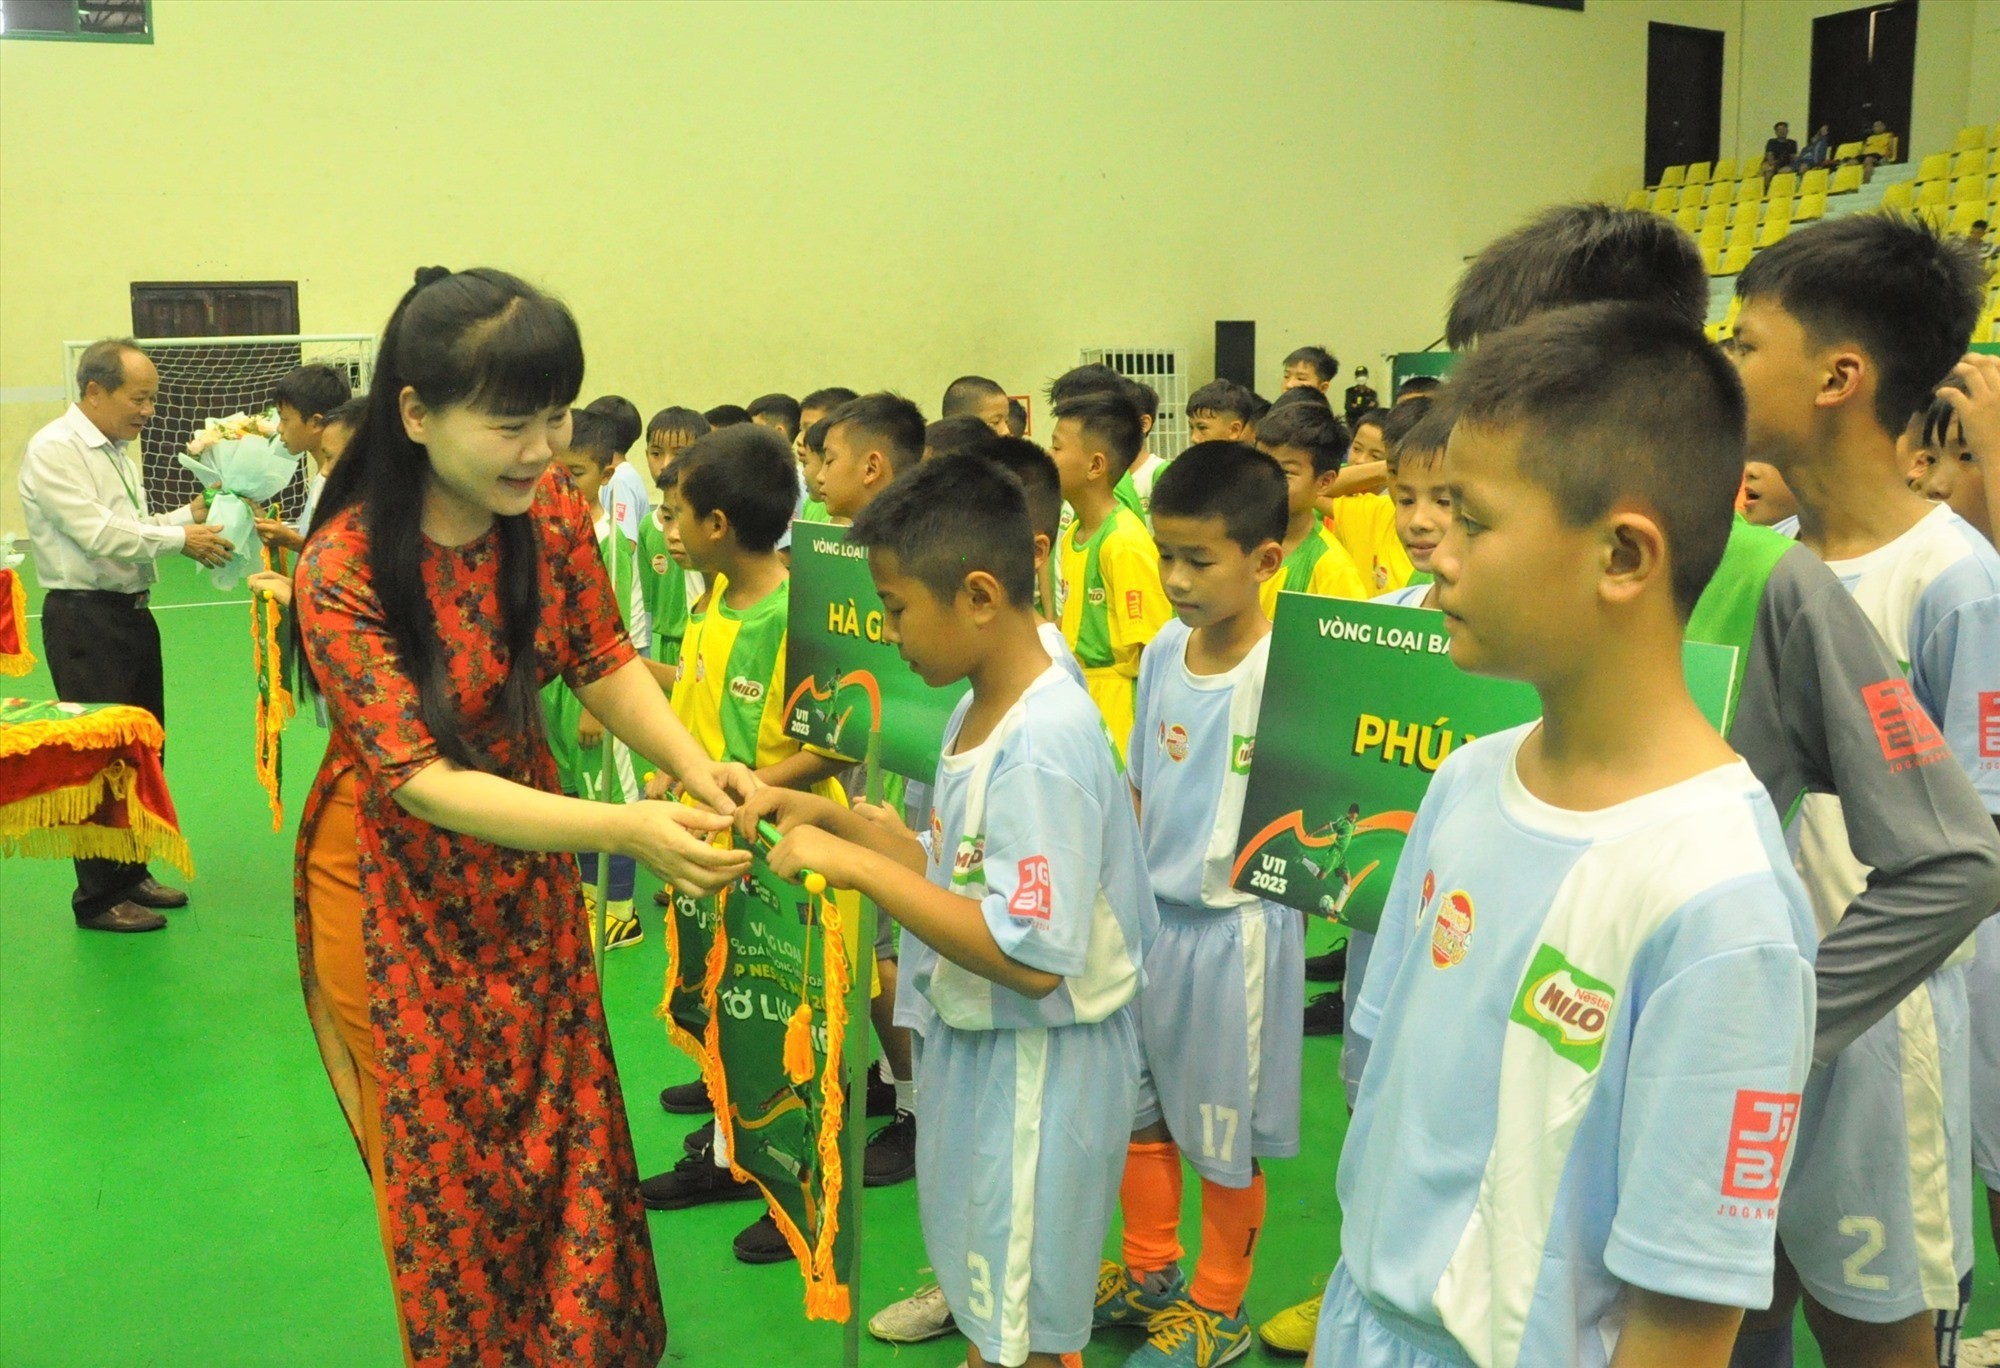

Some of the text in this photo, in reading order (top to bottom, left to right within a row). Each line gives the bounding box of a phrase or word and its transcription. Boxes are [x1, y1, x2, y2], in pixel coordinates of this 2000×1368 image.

[813, 537, 840, 556] VÒNG
[841, 545, 864, 563] LOẠI
[828, 598, 860, 638] HÀ
[1318, 615, 1372, 643] VÒNG
[1376, 626, 1423, 655] LOẠI
[731, 681, 760, 697] MILO
[791, 720, 810, 736] 2023
[1354, 713, 1450, 771] PHÚ
[1250, 869, 1289, 895] 2023
[1261, 852, 1288, 876] U11
[1539, 982, 1606, 1033] MILO
[1199, 1103, 1239, 1163] 17
[1838, 1215, 1889, 1291] 2
[966, 1250, 995, 1321] 3
